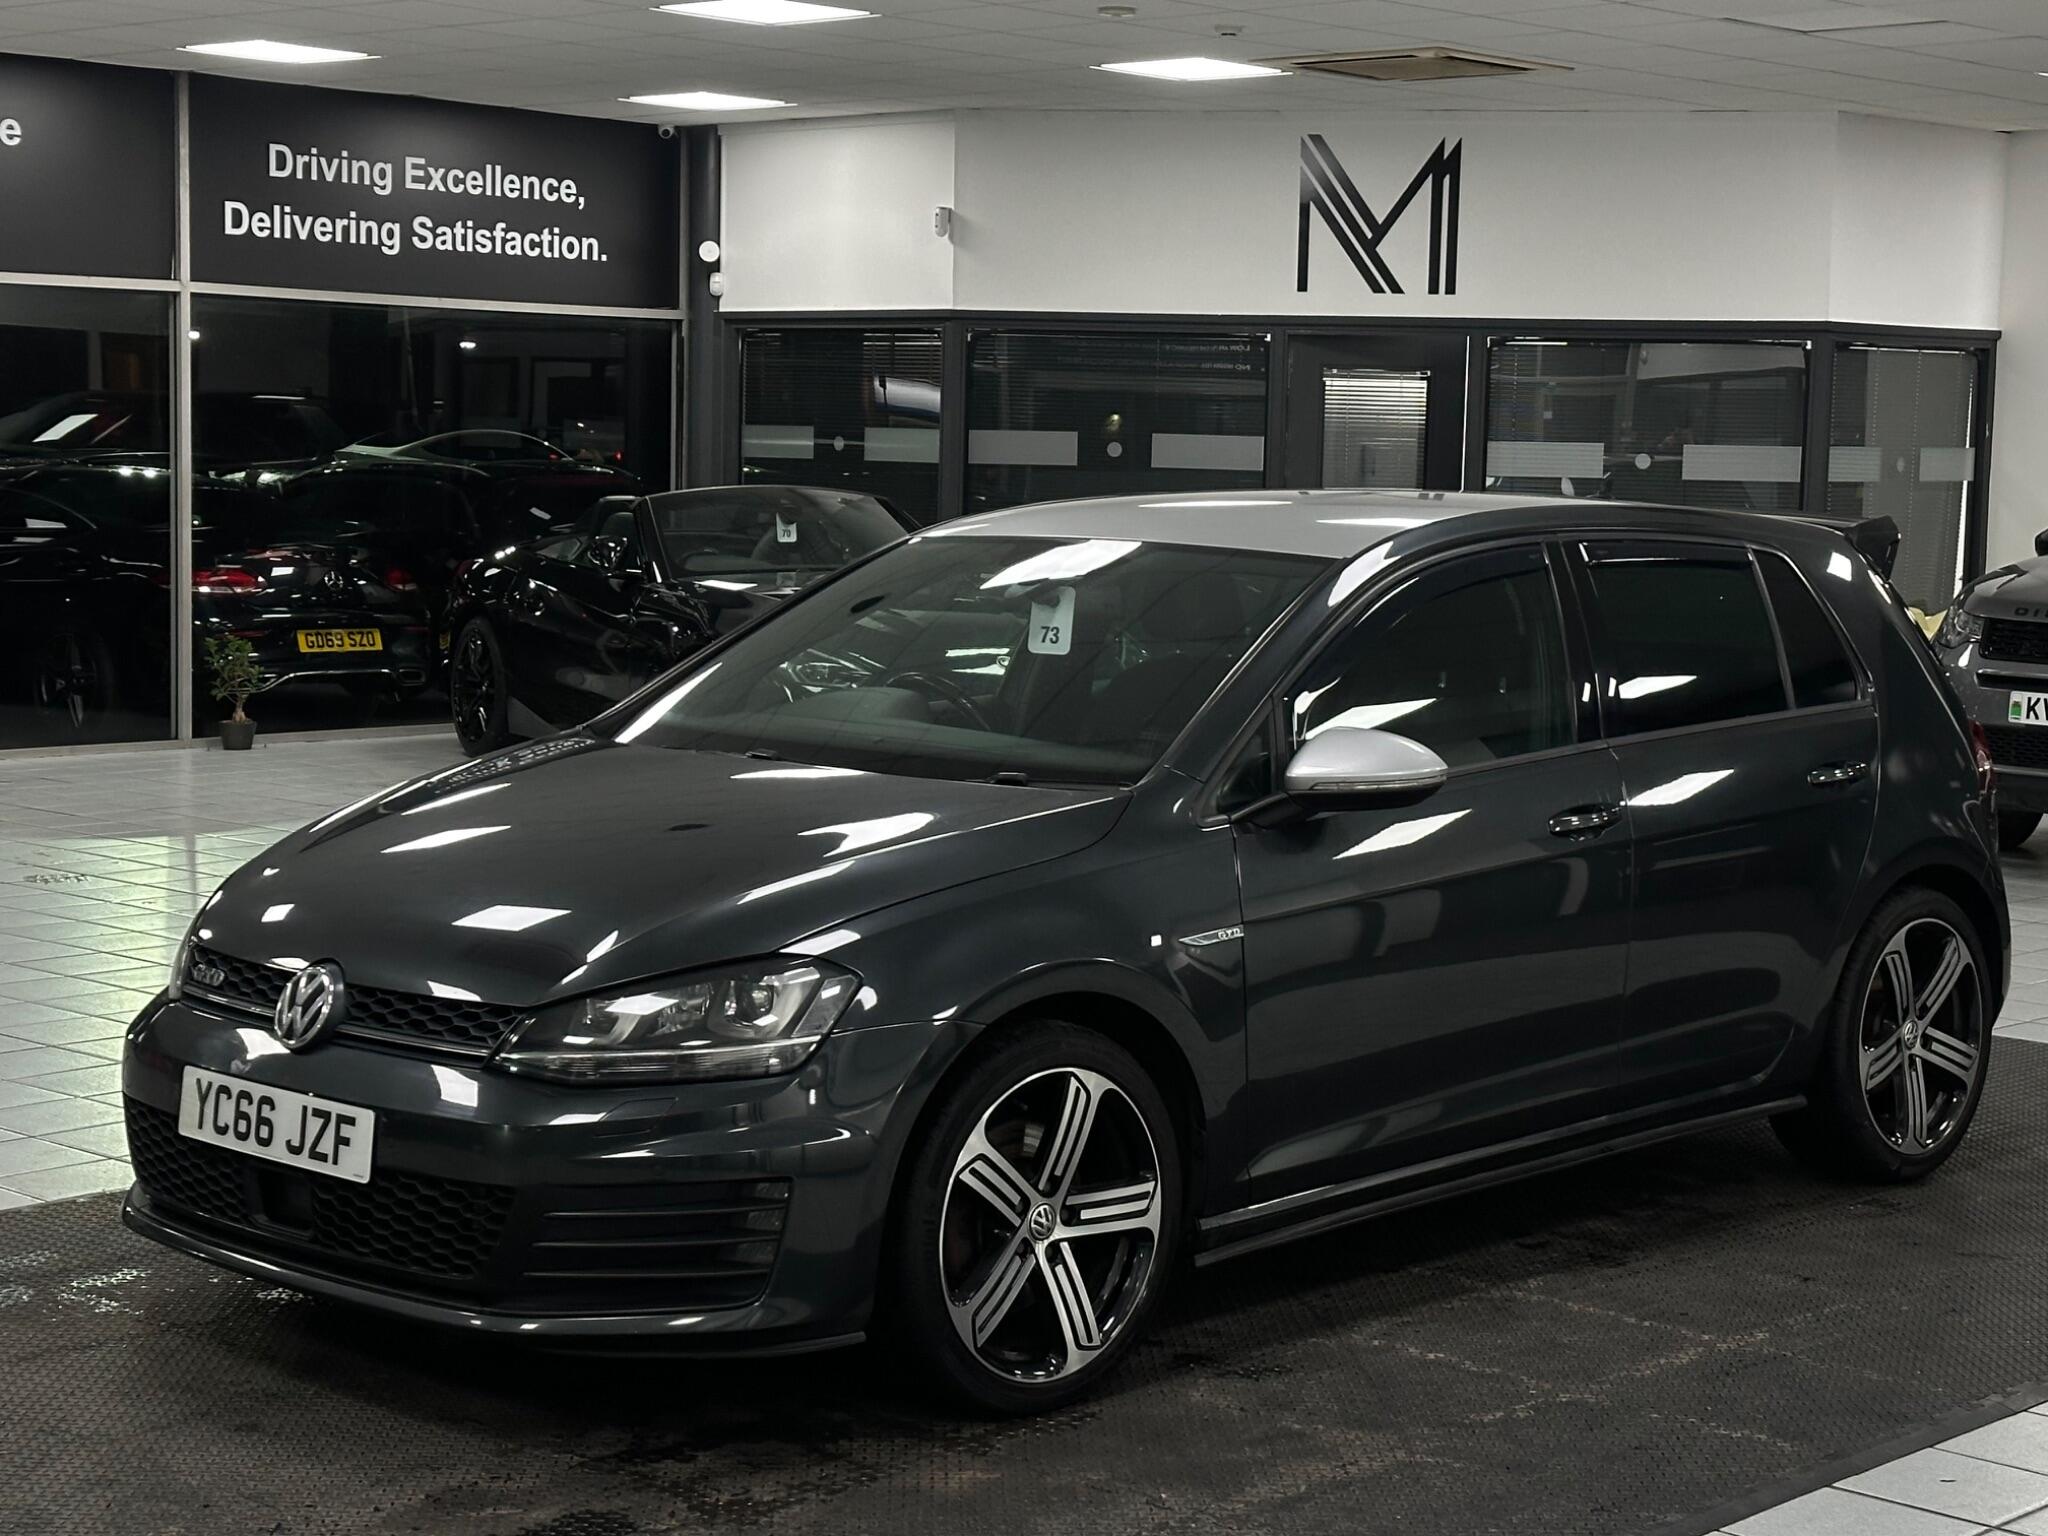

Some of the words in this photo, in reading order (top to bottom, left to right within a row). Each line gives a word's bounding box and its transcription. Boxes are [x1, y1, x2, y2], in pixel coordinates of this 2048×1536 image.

[268, 143, 393, 196] Driving
[404, 156, 585, 210] Excellence,
[224, 200, 401, 256] Delivering
[411, 215, 608, 262] Satisfaction.
[782, 529, 792, 538] 70
[2014, 607, 2048, 619] DI
[304, 631, 345, 649] GD69
[1041, 626, 1060, 645] 73
[196, 1077, 276, 1148] YC66
[285, 1104, 357, 1167] JZF
